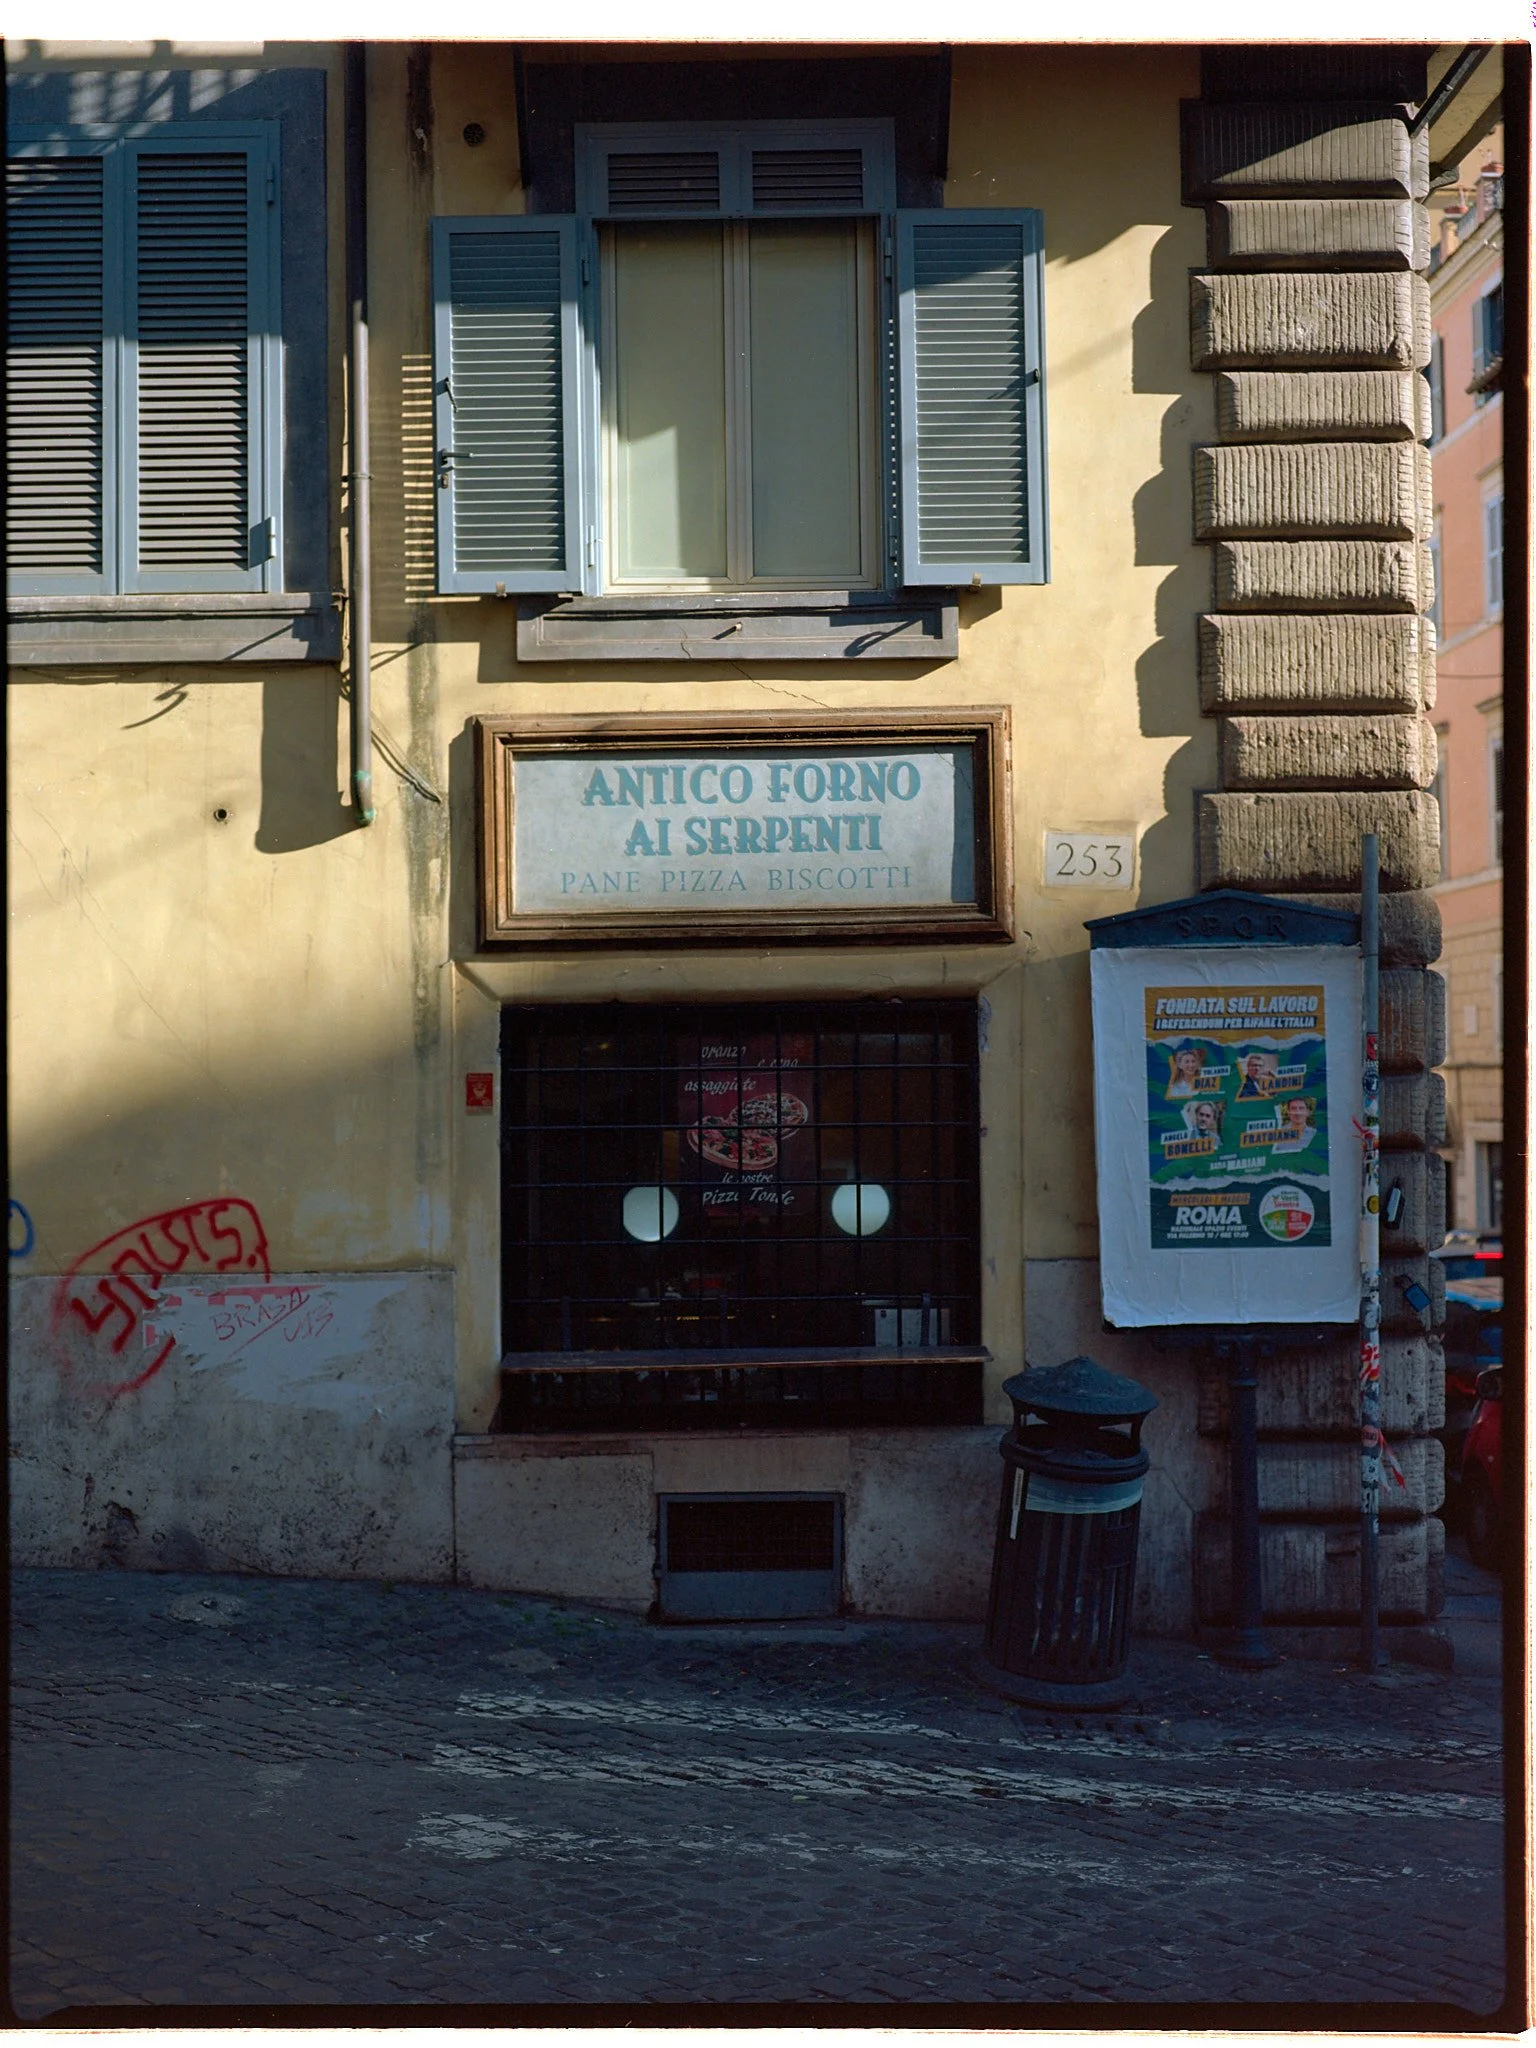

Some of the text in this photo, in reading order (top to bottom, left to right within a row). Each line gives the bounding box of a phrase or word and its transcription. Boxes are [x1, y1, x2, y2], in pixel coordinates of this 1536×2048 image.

[582, 761, 921, 809] ANTICO FORNO
[624, 813, 883, 856] AI SERPENTI
[1056, 842, 1122, 877] 253
[561, 866, 911, 894] PANE PIZZA BISCOTTI
[1156, 994, 1318, 1015] FONDATA SUL LAVORO
[1161, 1018, 1223, 1029] REFERENDUM
[1224, 1017, 1243, 1028] PER
[1243, 1017, 1276, 1028] RIFARE
[1277, 1016, 1315, 1028] L'ITALIA
[769, 1058, 799, 1067] cna
[1194, 1076, 1217, 1089] DIAZ
[1261, 1075, 1302, 1091] LANDINI
[1248, 1121, 1274, 1131] NICOLA
[1243, 1129, 1299, 1145] FRATOIANNI
[1167, 1142, 1211, 1156] BONELLI
[1175, 1206, 1242, 1225] ROMA
